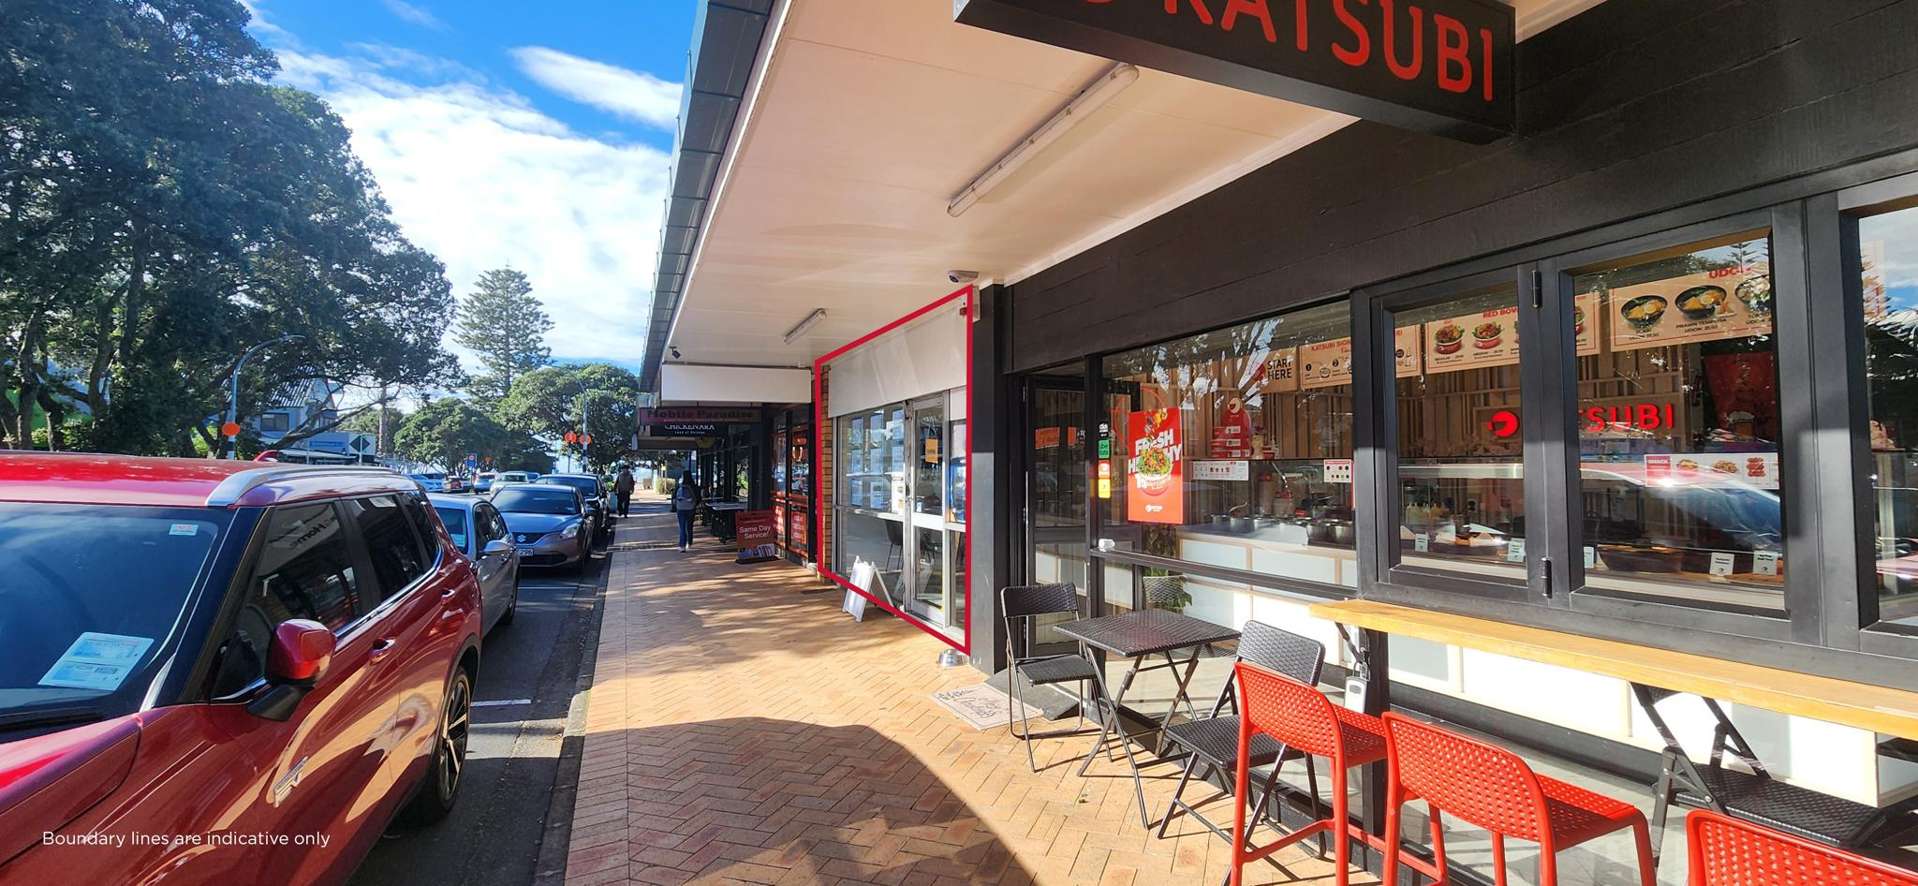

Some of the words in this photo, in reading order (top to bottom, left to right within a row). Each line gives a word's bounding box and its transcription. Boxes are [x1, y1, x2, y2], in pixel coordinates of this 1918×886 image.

[1267, 368, 1292, 380] HERE
[1577, 402, 1674, 433] SUBI
[739, 526, 758, 534] Same
[759, 525, 771, 535] Day
